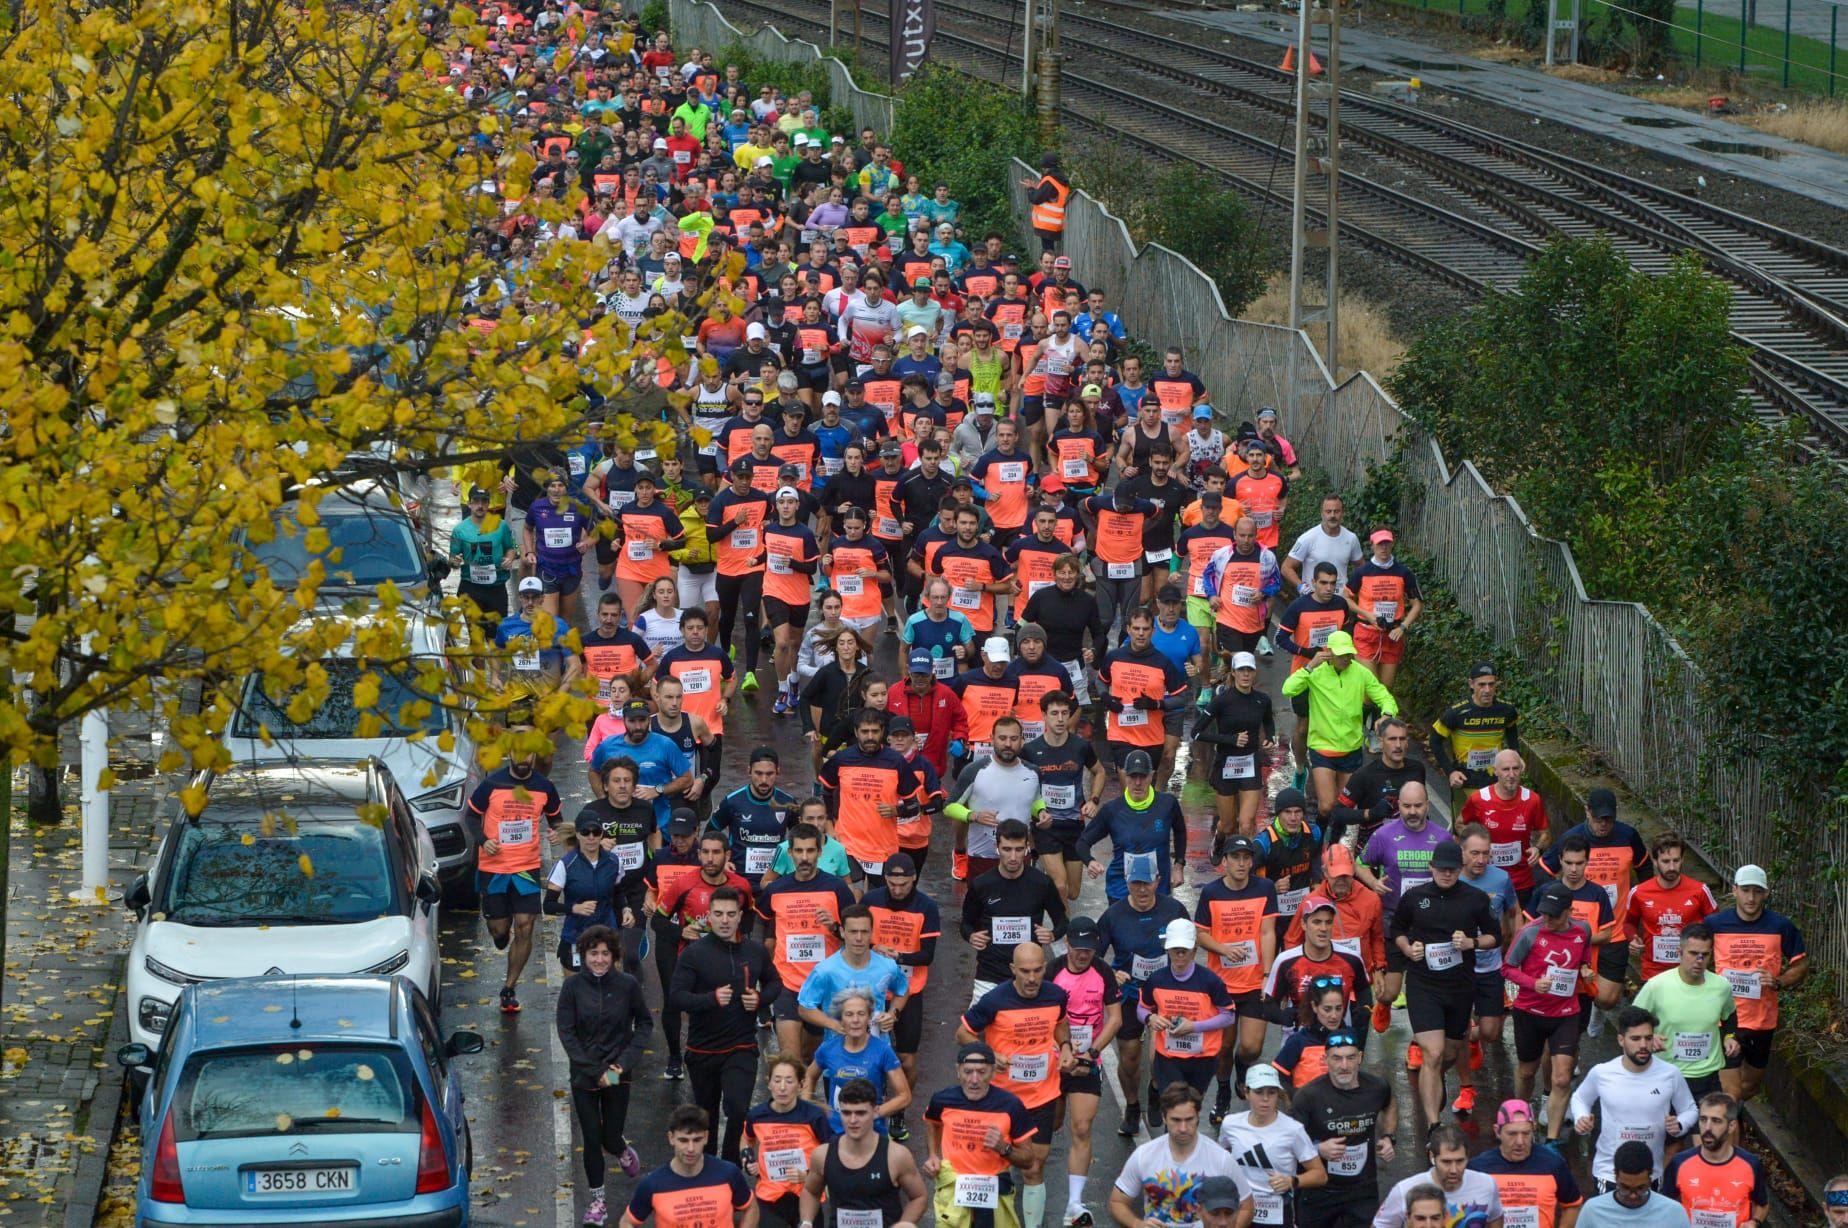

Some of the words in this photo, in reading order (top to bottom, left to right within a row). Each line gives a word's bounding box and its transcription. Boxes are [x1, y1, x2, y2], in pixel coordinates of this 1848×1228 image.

[900, 0, 926, 78] kutx
[1732, 985, 1750, 993] 2790
[1685, 1050, 1702, 1058] 1225
[1342, 1162, 1357, 1170] 855
[262, 1172, 307, 1190] 3658
[316, 1170, 349, 1188] CKN
[966, 1192, 988, 1202] 3242
